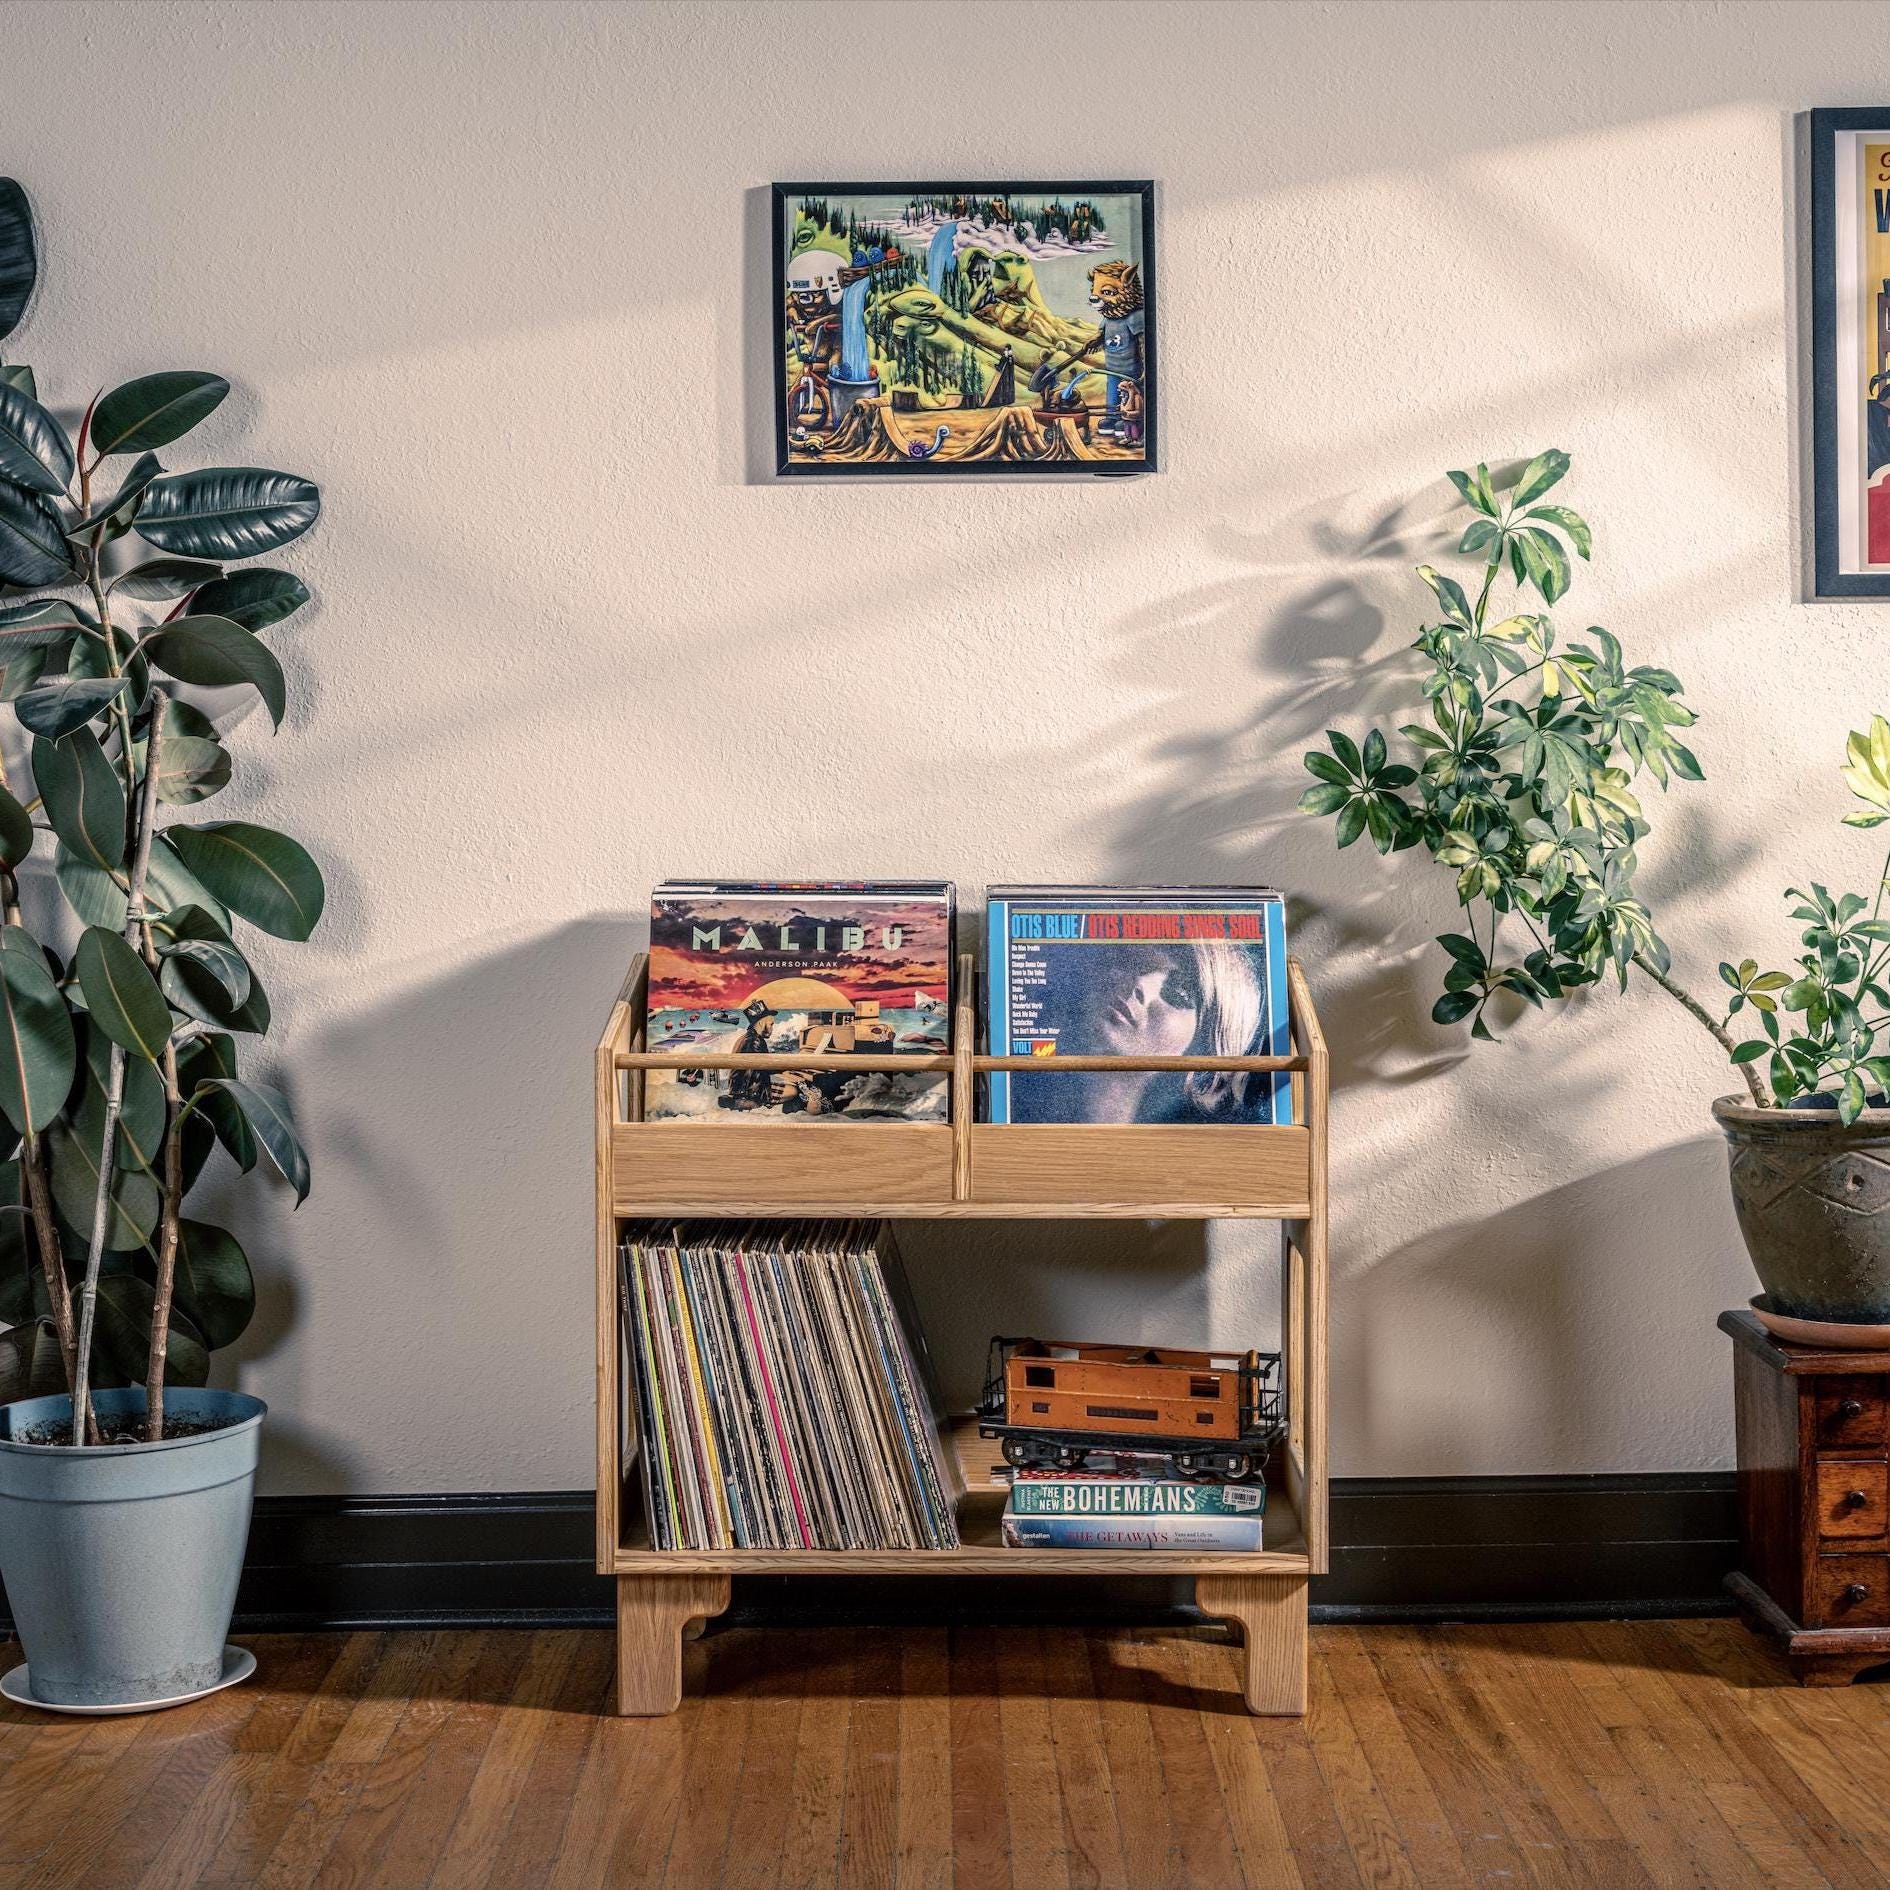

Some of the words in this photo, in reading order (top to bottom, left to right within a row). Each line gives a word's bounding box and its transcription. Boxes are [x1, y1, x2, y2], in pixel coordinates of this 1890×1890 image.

[1011, 914, 1042, 938] OTIS
[1046, 914, 1078, 938] BLUE
[1088, 914, 1119, 938] OTIS
[1123, 914, 1180, 938] REDDING
[1184, 914, 1226, 938] SINGS
[1229, 914, 1262, 938] SOUL
[692, 925, 903, 951] MALIBU
[1012, 1041, 1032, 1054] VOLT
[1041, 1486, 1060, 1498] THE
[1063, 1485, 1196, 1512] BOHEMIANS
[1039, 1499, 1059, 1511] NEW
[1022, 1532, 1051, 1540] gestalten
[1066, 1531, 1092, 1542] THE
[1096, 1531, 1169, 1543] GETAWAYS
